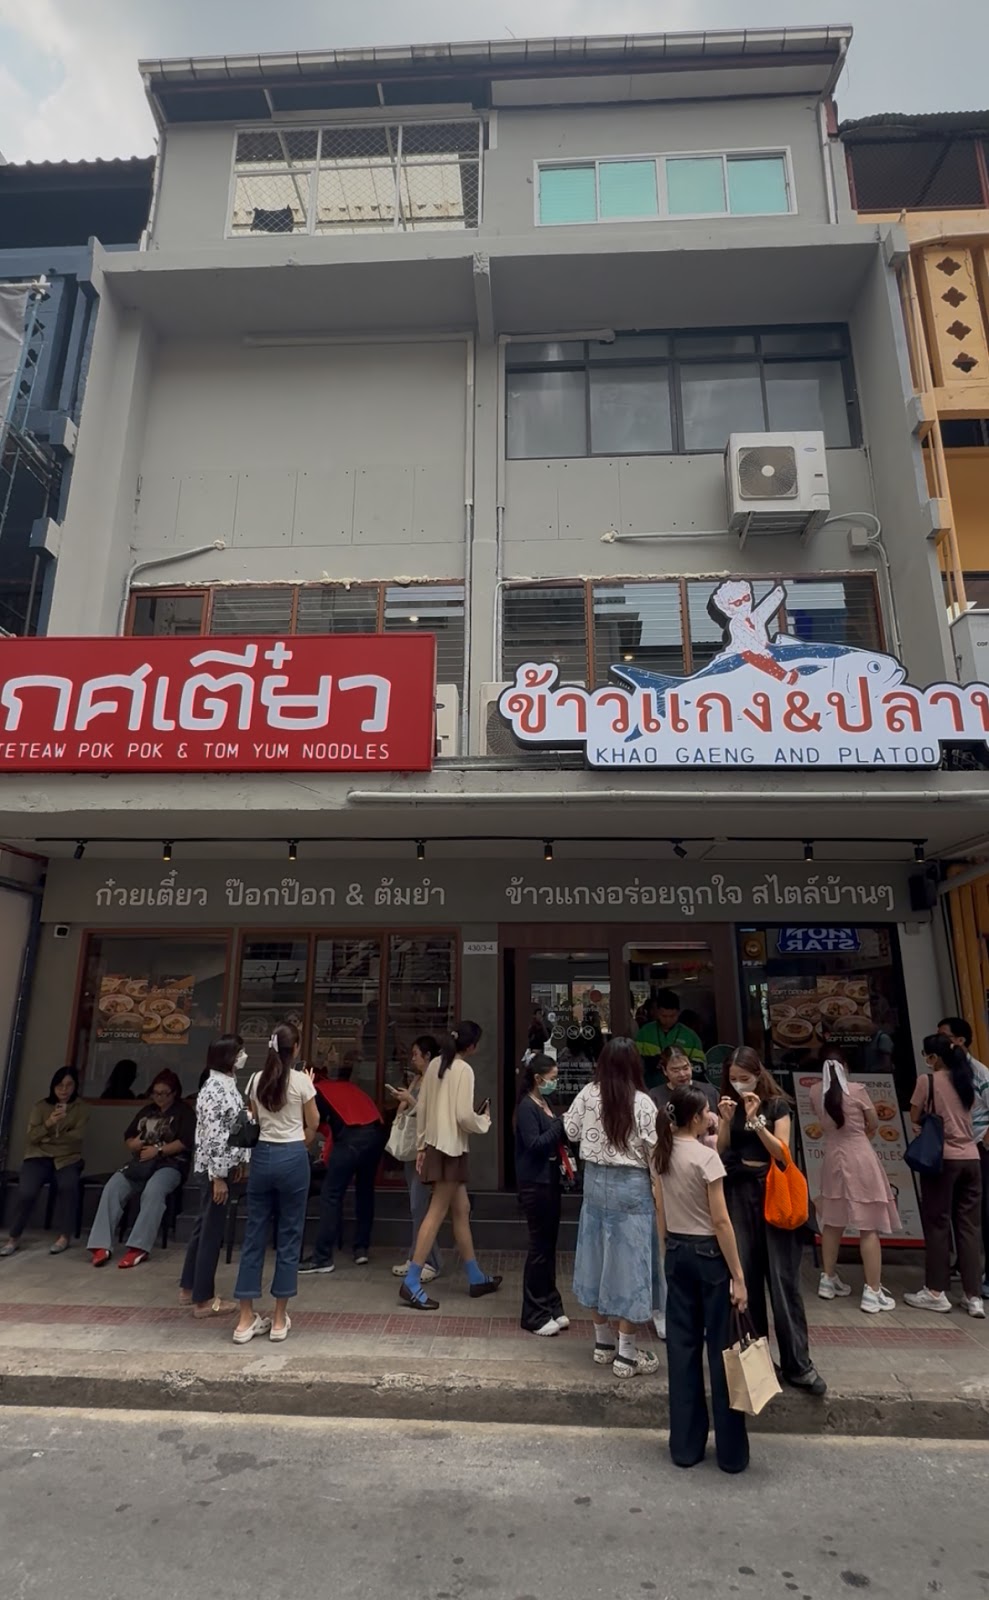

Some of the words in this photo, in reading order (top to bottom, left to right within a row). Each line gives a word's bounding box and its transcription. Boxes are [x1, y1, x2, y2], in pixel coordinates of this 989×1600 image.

[78, 743, 114, 758] POK
[127, 743, 163, 758] POK
[177, 743, 188, 758] &
[204, 743, 239, 758] TOM
[253, 743, 289, 758] YUM
[302, 744, 389, 760] NOODLES
[596, 747, 657, 763] KHAO
[676, 747, 754, 763] GAENG
[774, 747, 819, 763] AND
[839, 747, 934, 763] PLATOO
[96, 869, 208, 906] ก๋วยเตี๋ยว
[225, 878, 336, 906] ป๊อกป๊อก
[345, 883, 365, 906] &
[374, 877, 445, 906] ต้มยำ
[505, 874, 742, 915] ข้าวแกงอร่อยถูกใจ
[751, 874, 894, 911] สไตล์บ้านๆ
[876, 1150, 904, 1161] DLES
